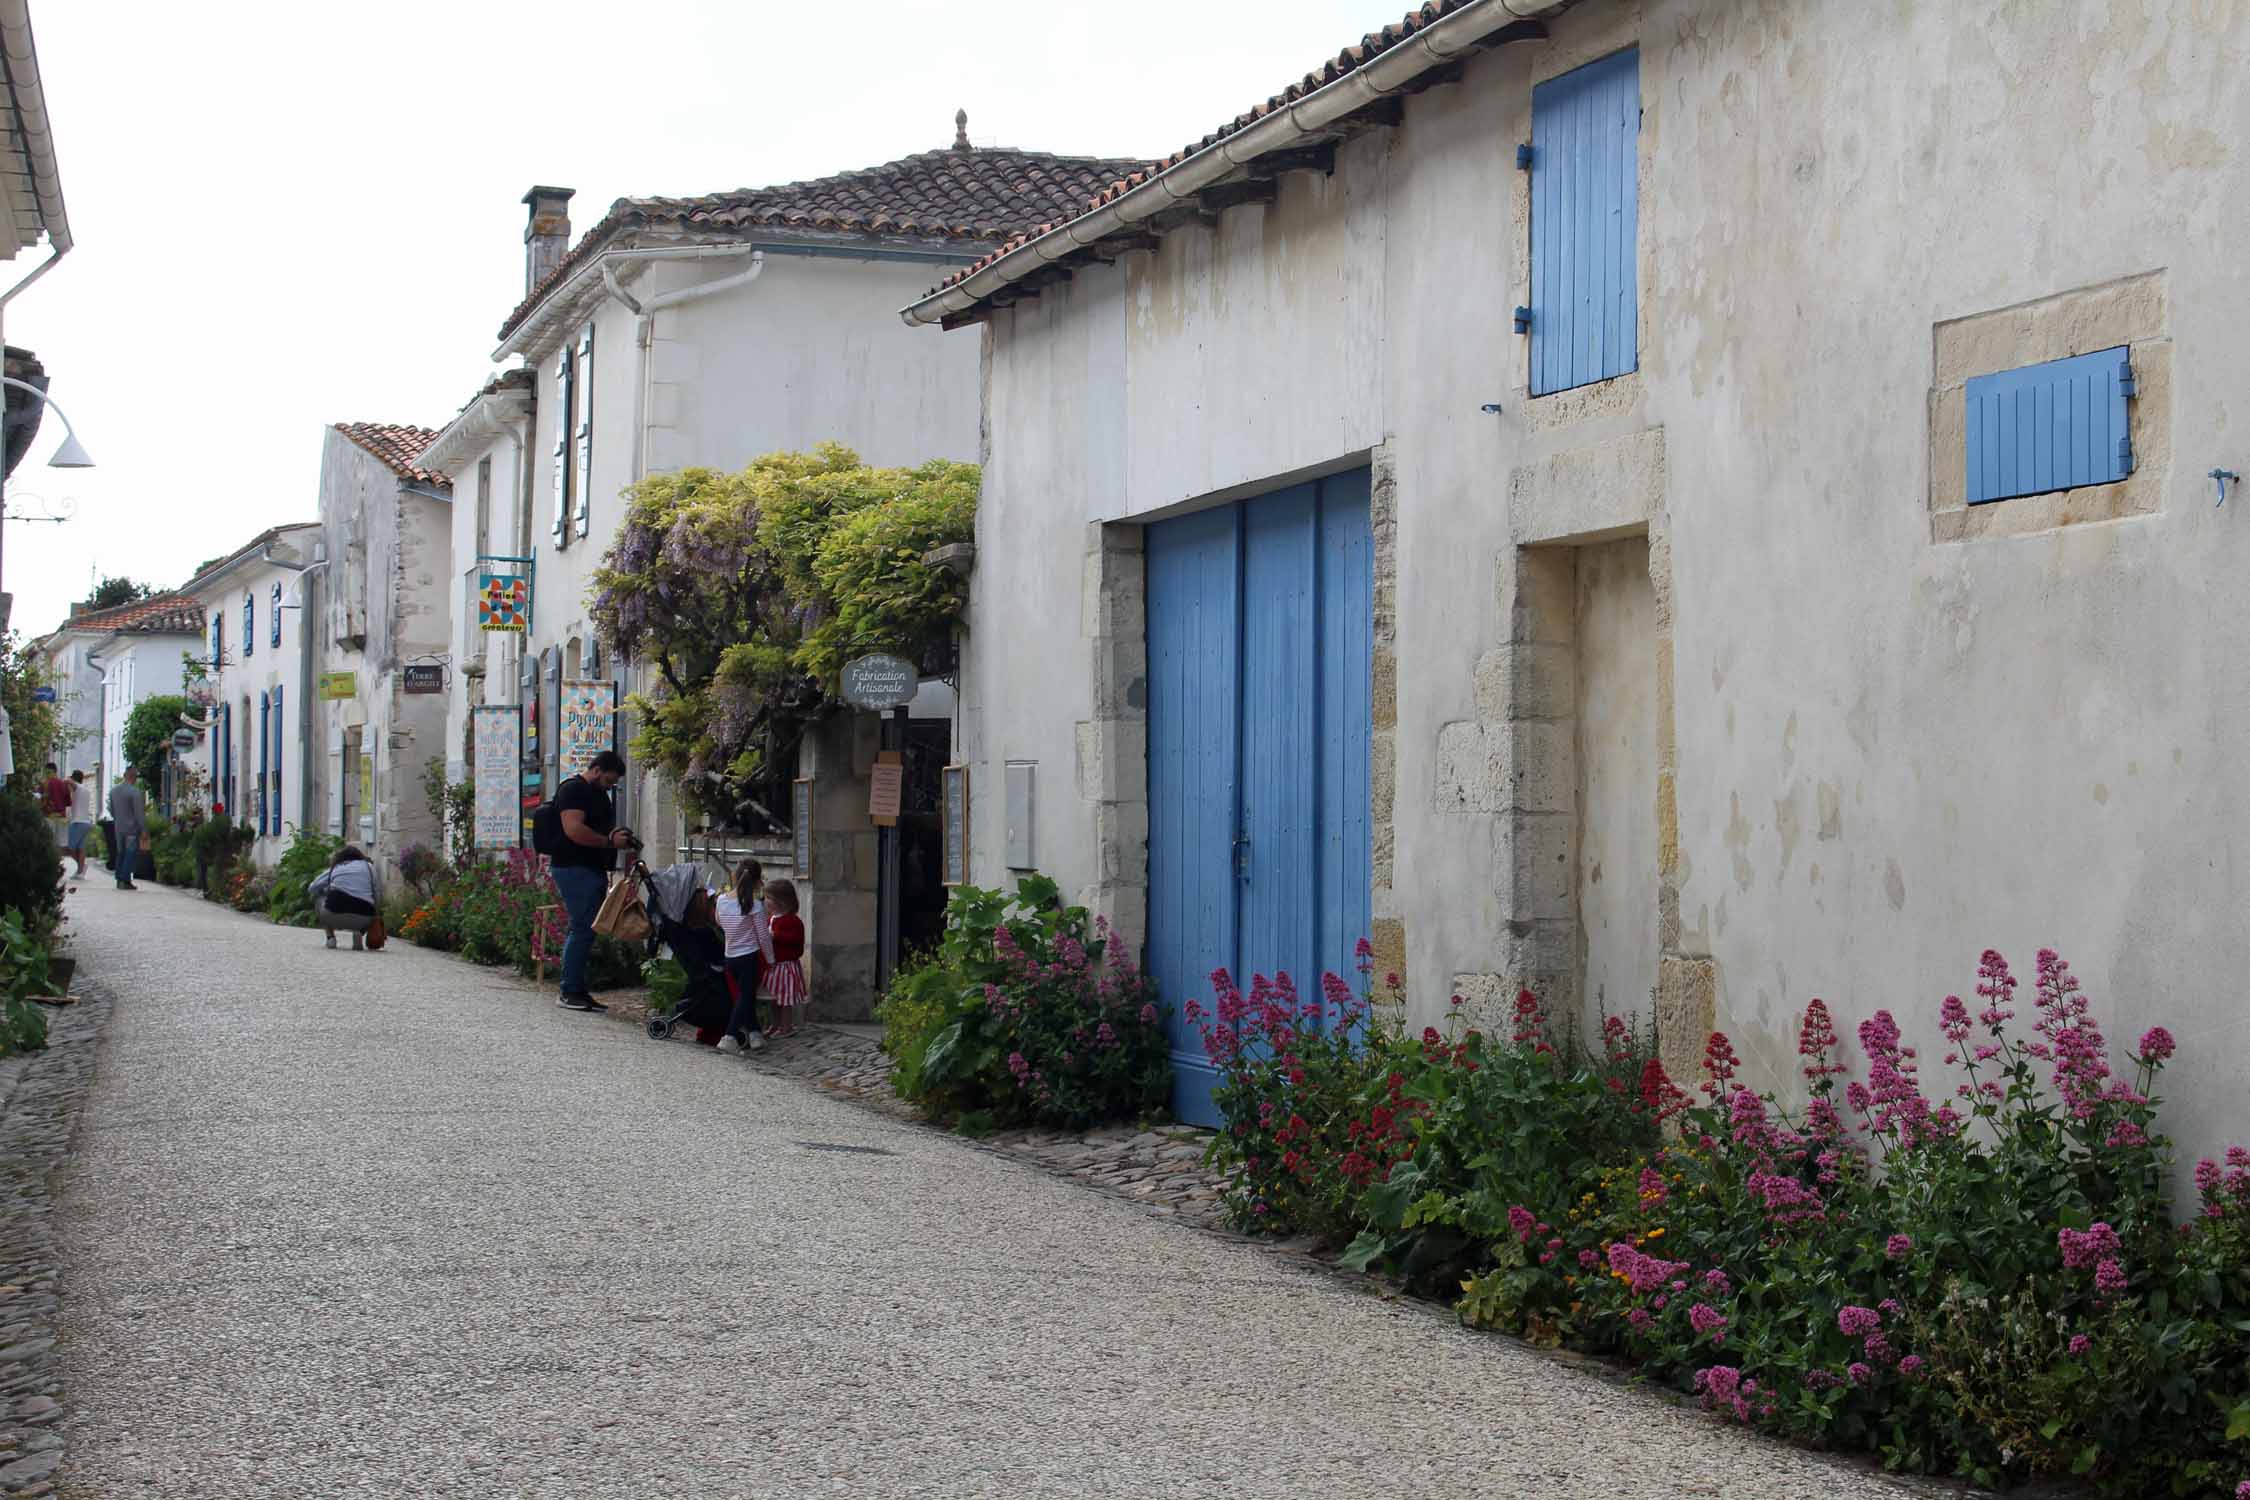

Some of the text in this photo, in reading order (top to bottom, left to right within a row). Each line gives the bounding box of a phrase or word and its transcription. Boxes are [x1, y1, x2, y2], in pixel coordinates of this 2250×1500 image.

[851, 668, 907, 681] Fabrication
[853, 681, 904, 694] Artisanale
[568, 711, 606, 728] POTION
